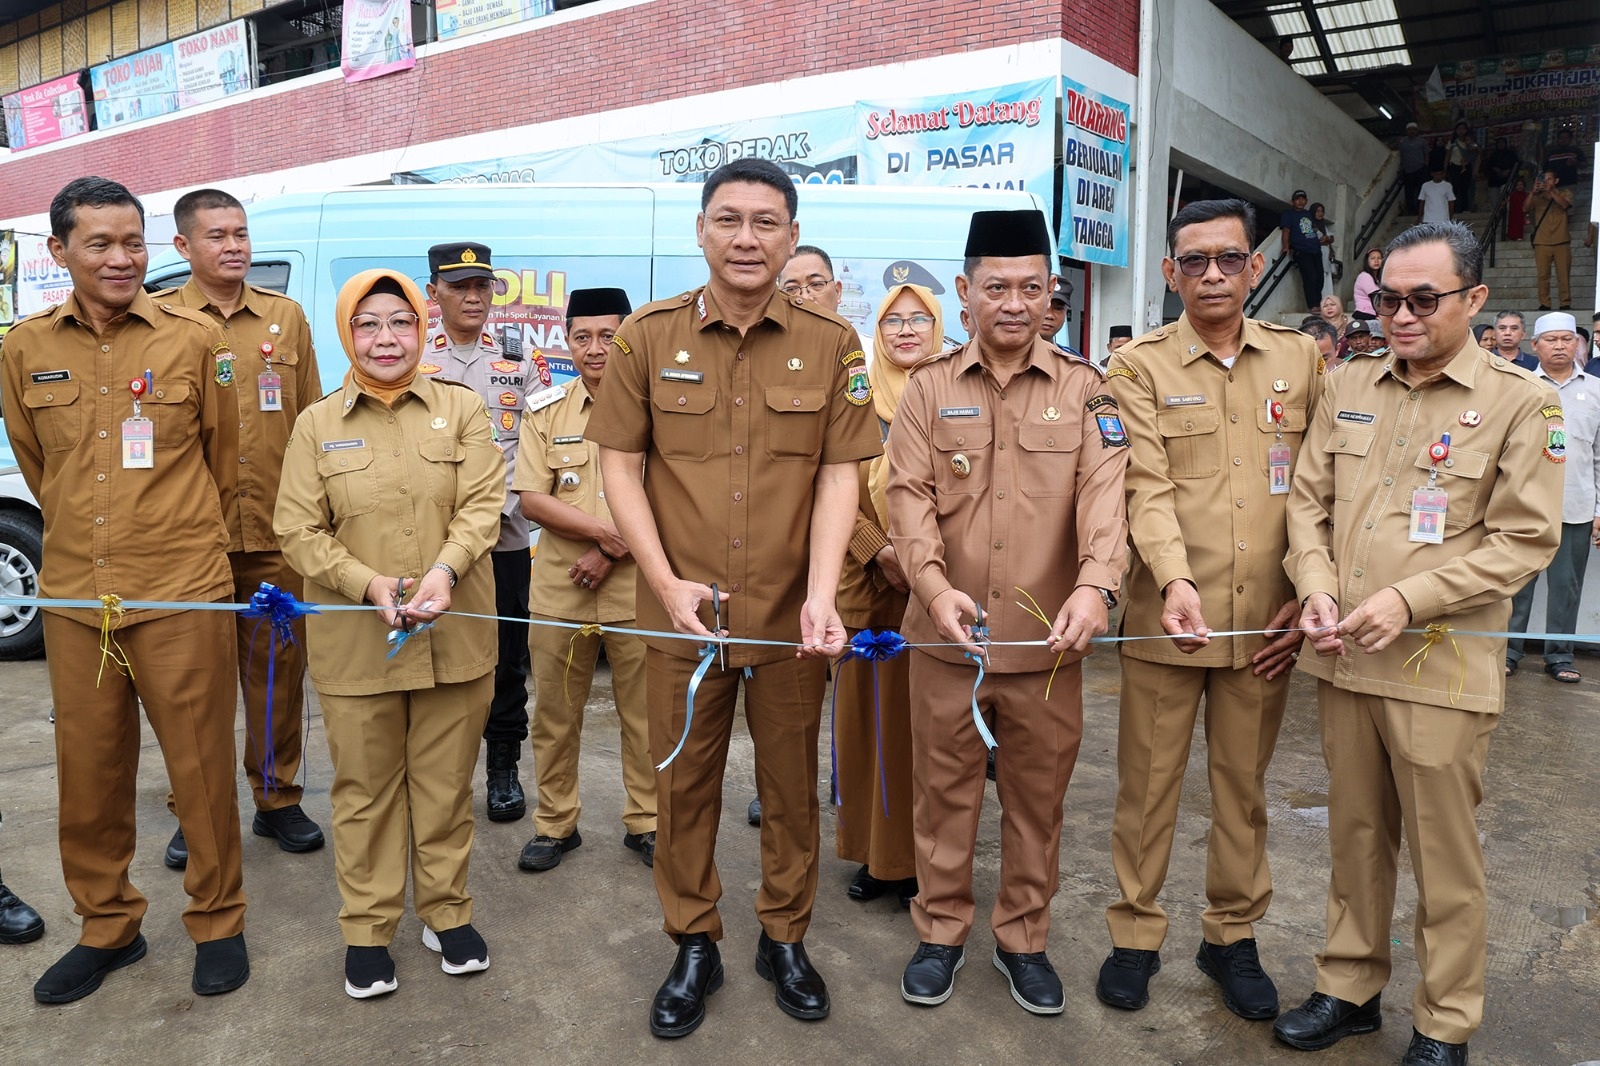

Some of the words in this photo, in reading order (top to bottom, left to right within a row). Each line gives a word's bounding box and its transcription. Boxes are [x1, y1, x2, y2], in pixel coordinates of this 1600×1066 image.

[178, 37, 208, 59] TOKO
[209, 26, 240, 49] NANI
[103, 63, 131, 88] TOKO
[1445, 83, 1472, 98] SRI
[1553, 86, 1598, 99] Minyak
[866, 106, 948, 140] Selamat
[953, 96, 1042, 128] Datang
[1067, 88, 1126, 144] DILARANG
[659, 143, 722, 176] TOKO
[887, 152, 910, 174] DI
[927, 142, 1015, 172] PASAR
[1066, 138, 1123, 182] BERJUALAN
[1075, 177, 1090, 207] DI
[1091, 181, 1115, 213] AREA
[1073, 216, 1114, 251] TANGGA
[43, 290, 64, 303] PASAR
[495, 311, 509, 319] The
[510, 312, 528, 321] Spot
[528, 312, 560, 322] Layanan
[490, 376, 524, 387] POLRI
[548, 362, 573, 372] NTEN
